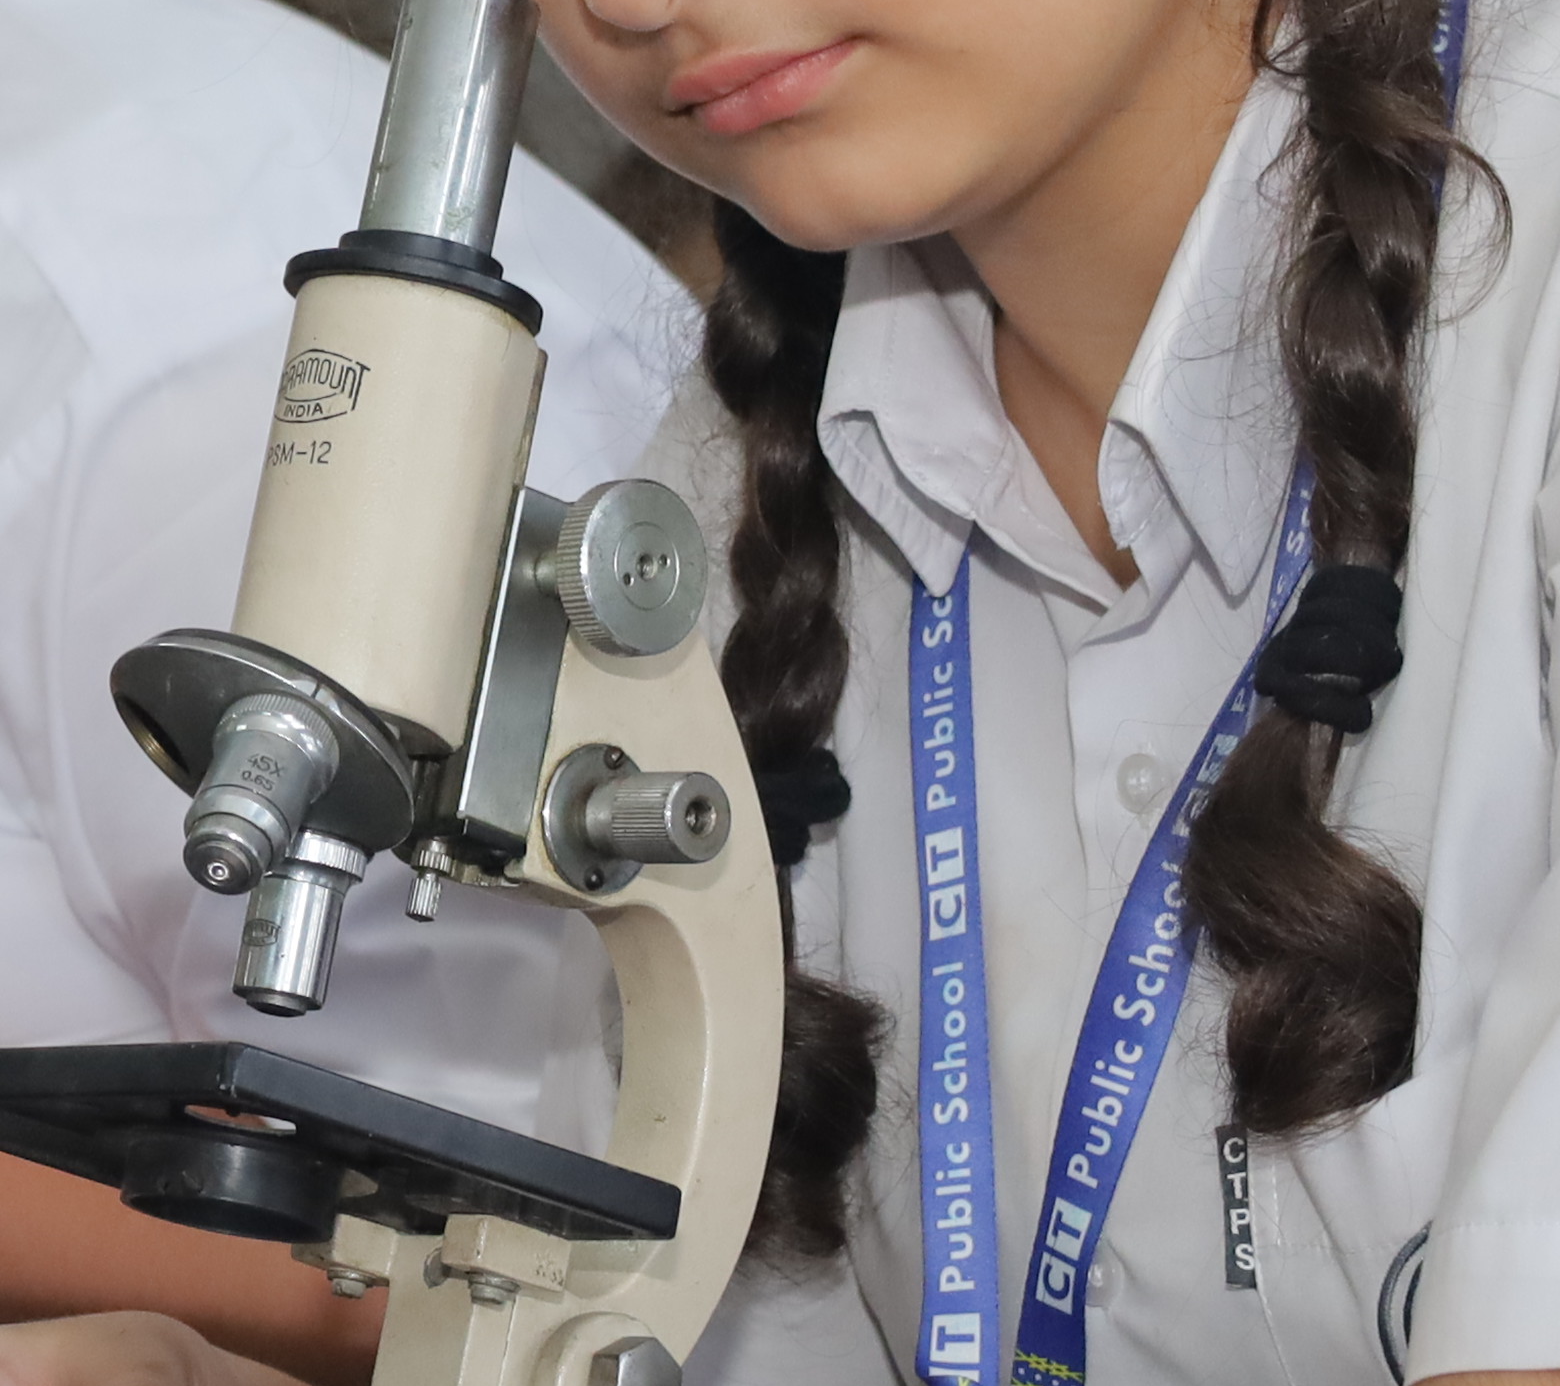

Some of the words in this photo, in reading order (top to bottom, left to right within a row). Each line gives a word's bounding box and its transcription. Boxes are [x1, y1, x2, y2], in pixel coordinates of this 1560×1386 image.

[284, 402, 323, 418] INDIA
[241, 770, 276, 791] 0.65
[247, 753, 284, 778] 45X
[923, 661, 957, 811] Public
[931, 961, 970, 1125] School
[1066, 1038, 1144, 1190] Public
[935, 1141, 976, 1293] Public
